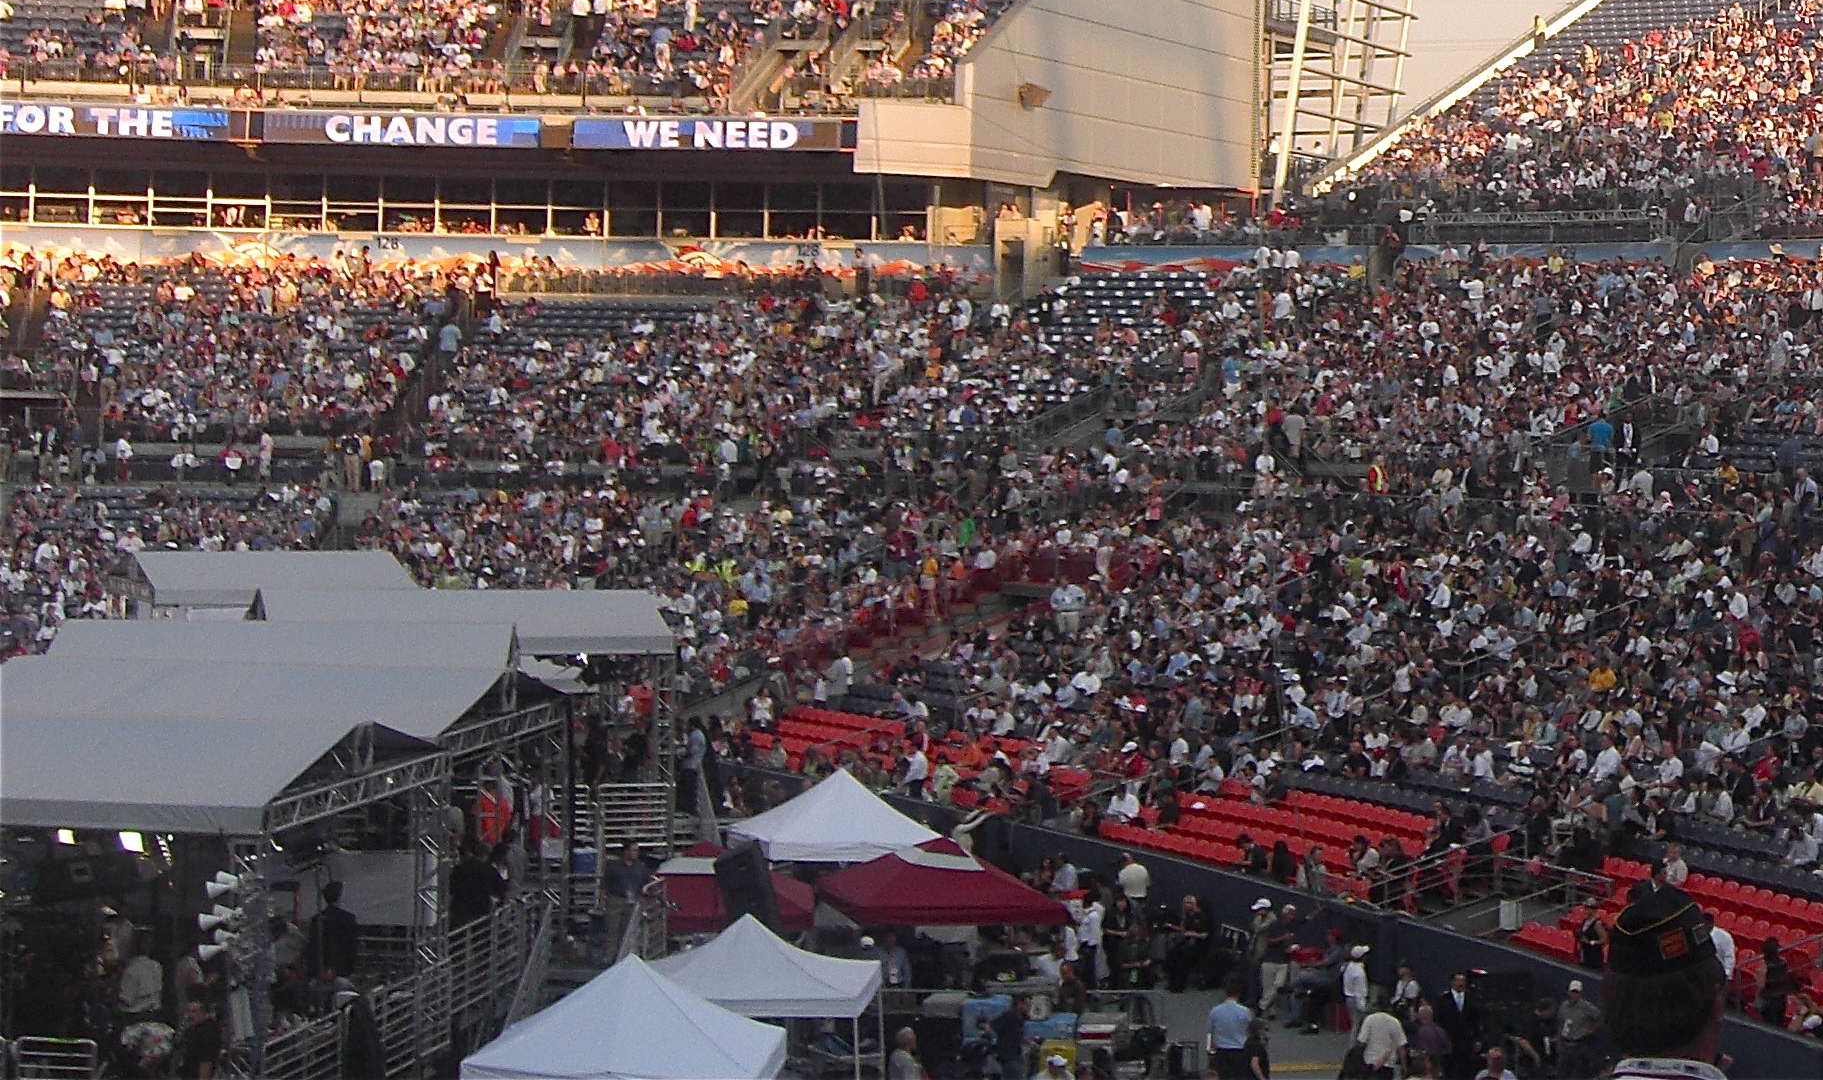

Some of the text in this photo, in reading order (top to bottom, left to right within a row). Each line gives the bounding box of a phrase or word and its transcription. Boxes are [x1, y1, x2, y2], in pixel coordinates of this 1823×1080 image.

[90, 107, 174, 137] THE
[324, 115, 499, 146] CHANGE
[623, 120, 799, 149] WE NEED
